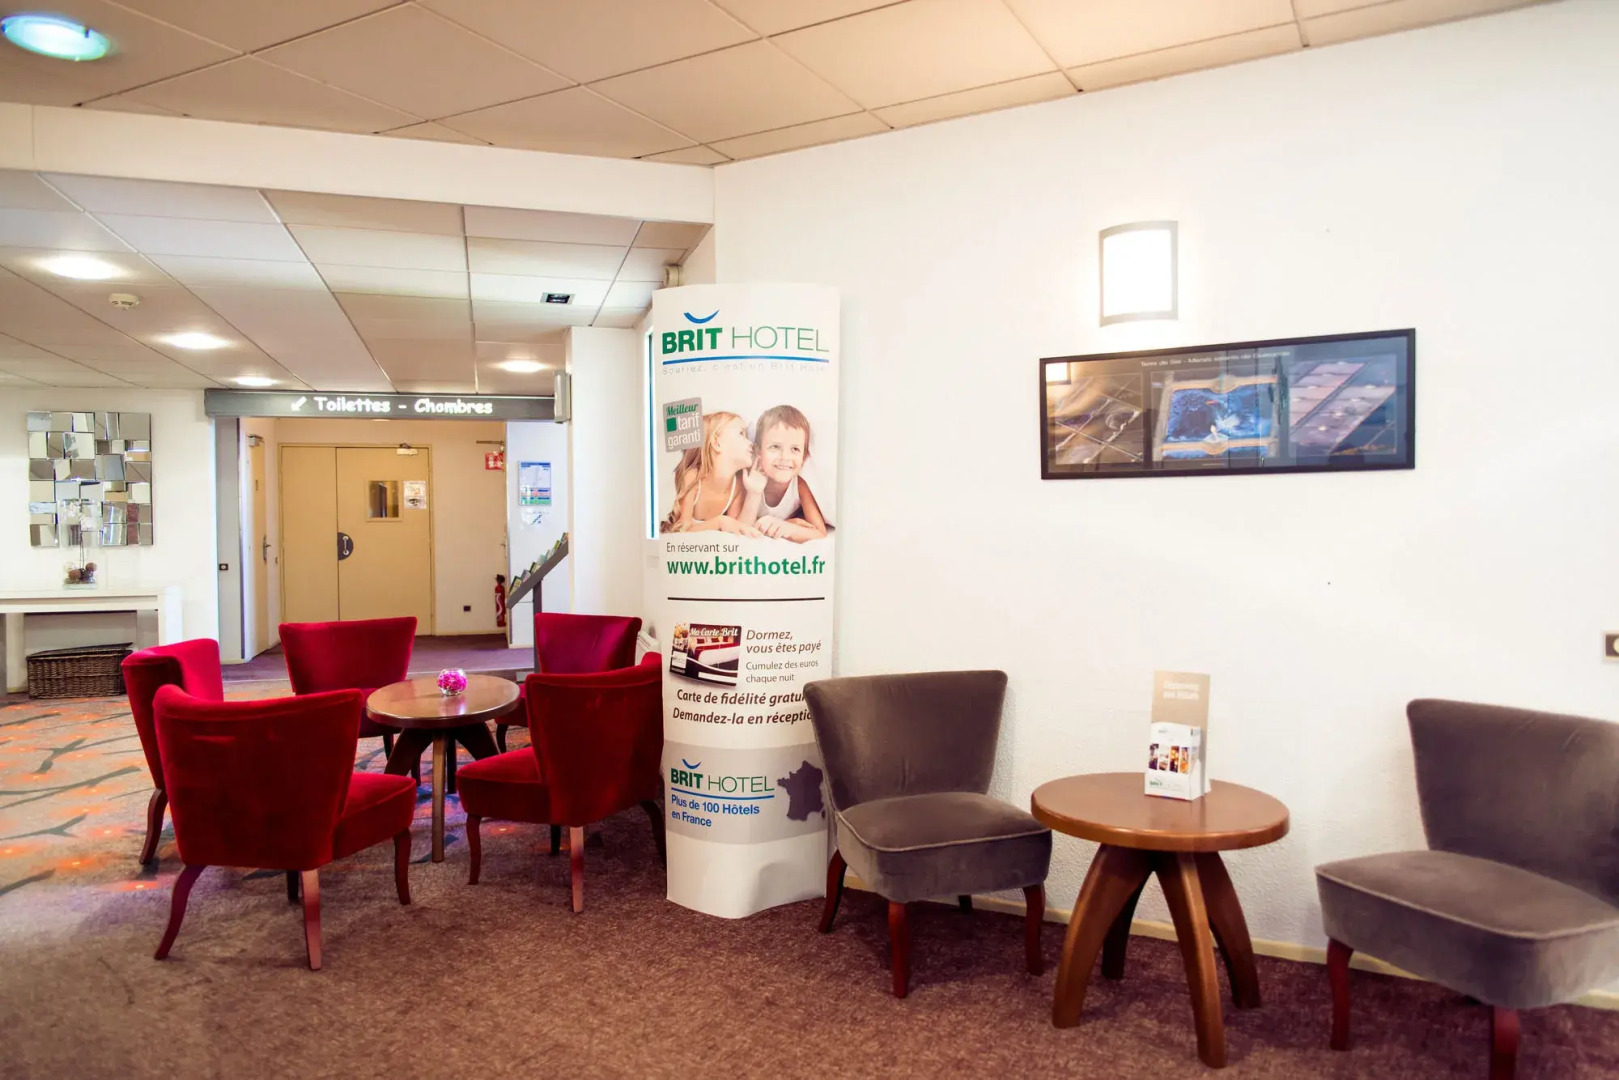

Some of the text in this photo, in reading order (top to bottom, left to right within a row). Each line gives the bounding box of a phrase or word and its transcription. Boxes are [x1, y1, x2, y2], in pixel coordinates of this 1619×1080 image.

[661, 326, 830, 355] BRIT HOTEL
[314, 396, 391, 413] Toilettes
[414, 398, 493, 414] Chambres
[666, 403, 699, 416] Meilleur
[678, 412, 700, 430] tarif
[668, 429, 701, 450] garanti
[666, 542, 740, 553] En réservant sur
[667, 555, 826, 575] www.brithotel.fr
[700, 627, 720, 636] Carte
[720, 627, 739, 637] Brit
[746, 629, 794, 641] Dormez,
[746, 640, 822, 655] vous êtes payé
[745, 660, 819, 671] Cumulez des euros
[745, 673, 795, 684] chaque nuit
[677, 689, 805, 707] Carte de fidélité gratu
[673, 707, 744, 725] Demandez-la
[748, 715, 763, 725] en
[670, 768, 775, 793] BRIT HOTEL
[671, 794, 760, 815] Plus de 100 Hôtels
[671, 811, 712, 827] en France
